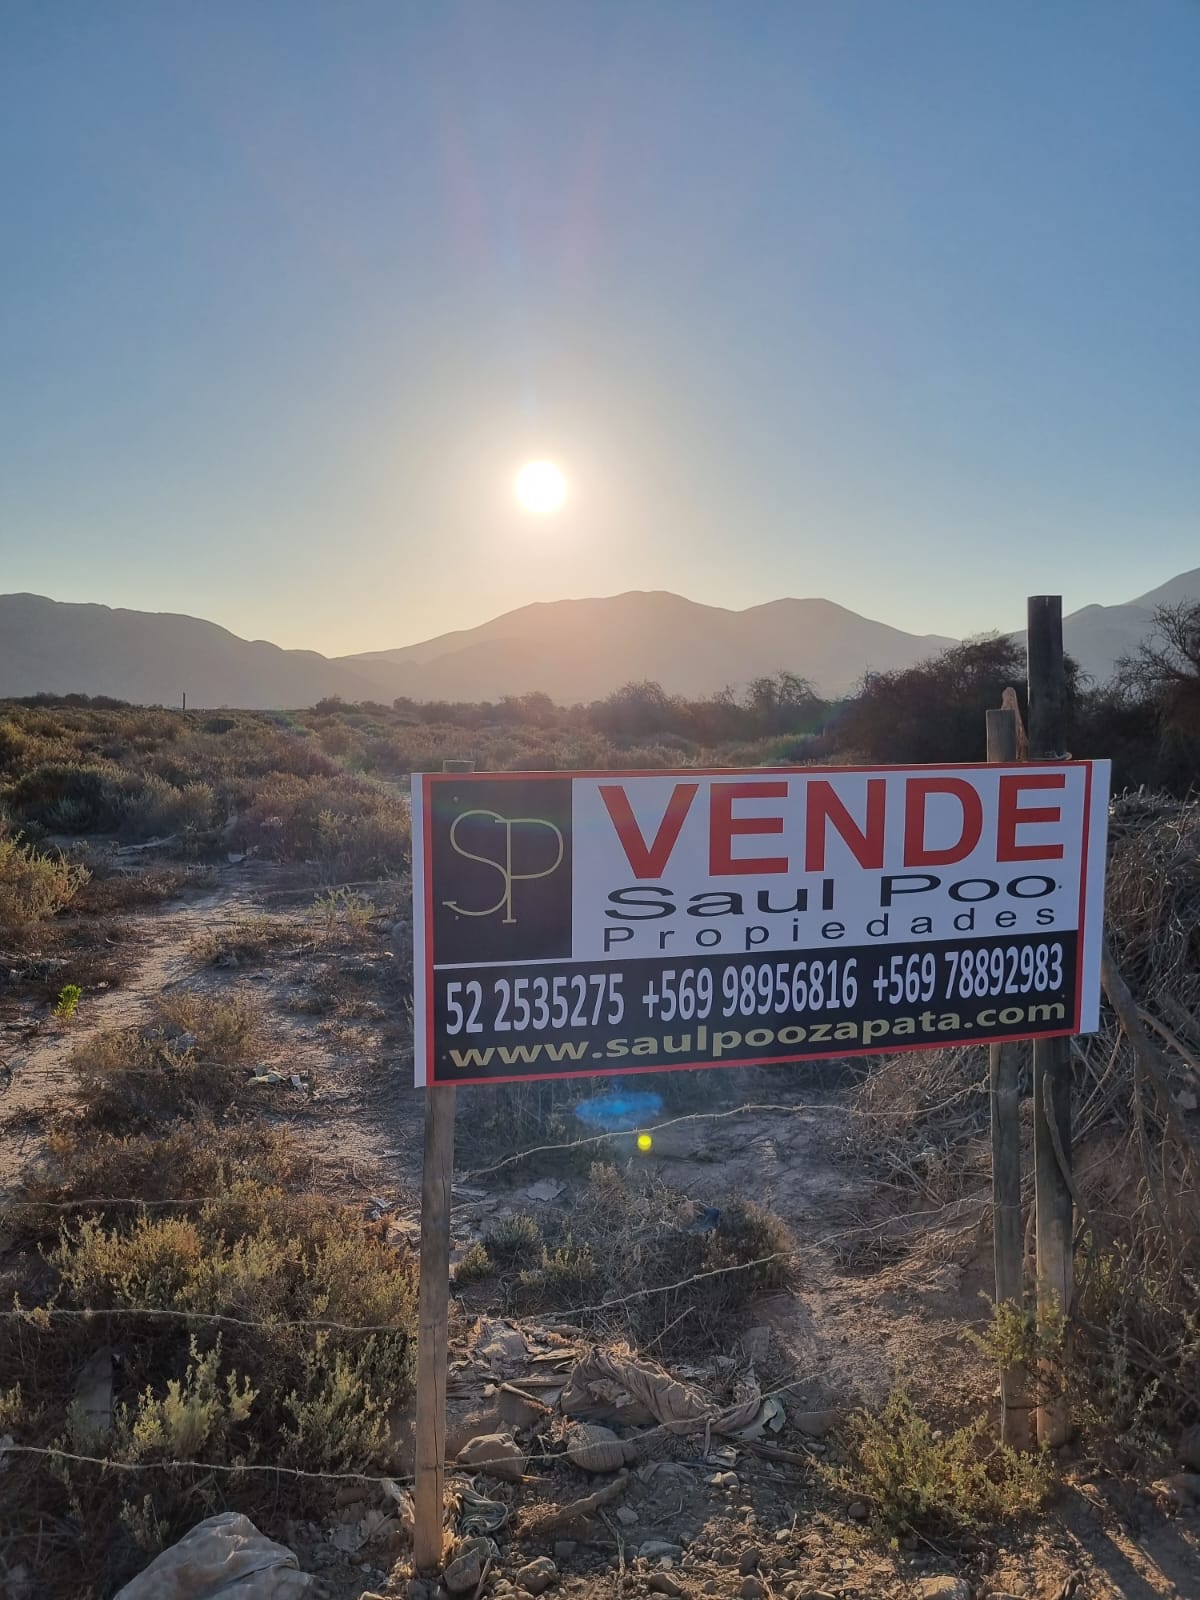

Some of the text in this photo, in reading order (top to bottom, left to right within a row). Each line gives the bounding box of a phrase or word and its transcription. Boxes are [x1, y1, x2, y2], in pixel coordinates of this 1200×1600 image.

[598, 774, 1066, 880] VENDE
[603, 907, 1055, 952] Propiedades
[604, 874, 1057, 920] Saul Poo
[446, 942, 1063, 1035] 52 2535275 +569 98956816 +569 78892983
[450, 1001, 1065, 1068] www.saulpoozapata.com
